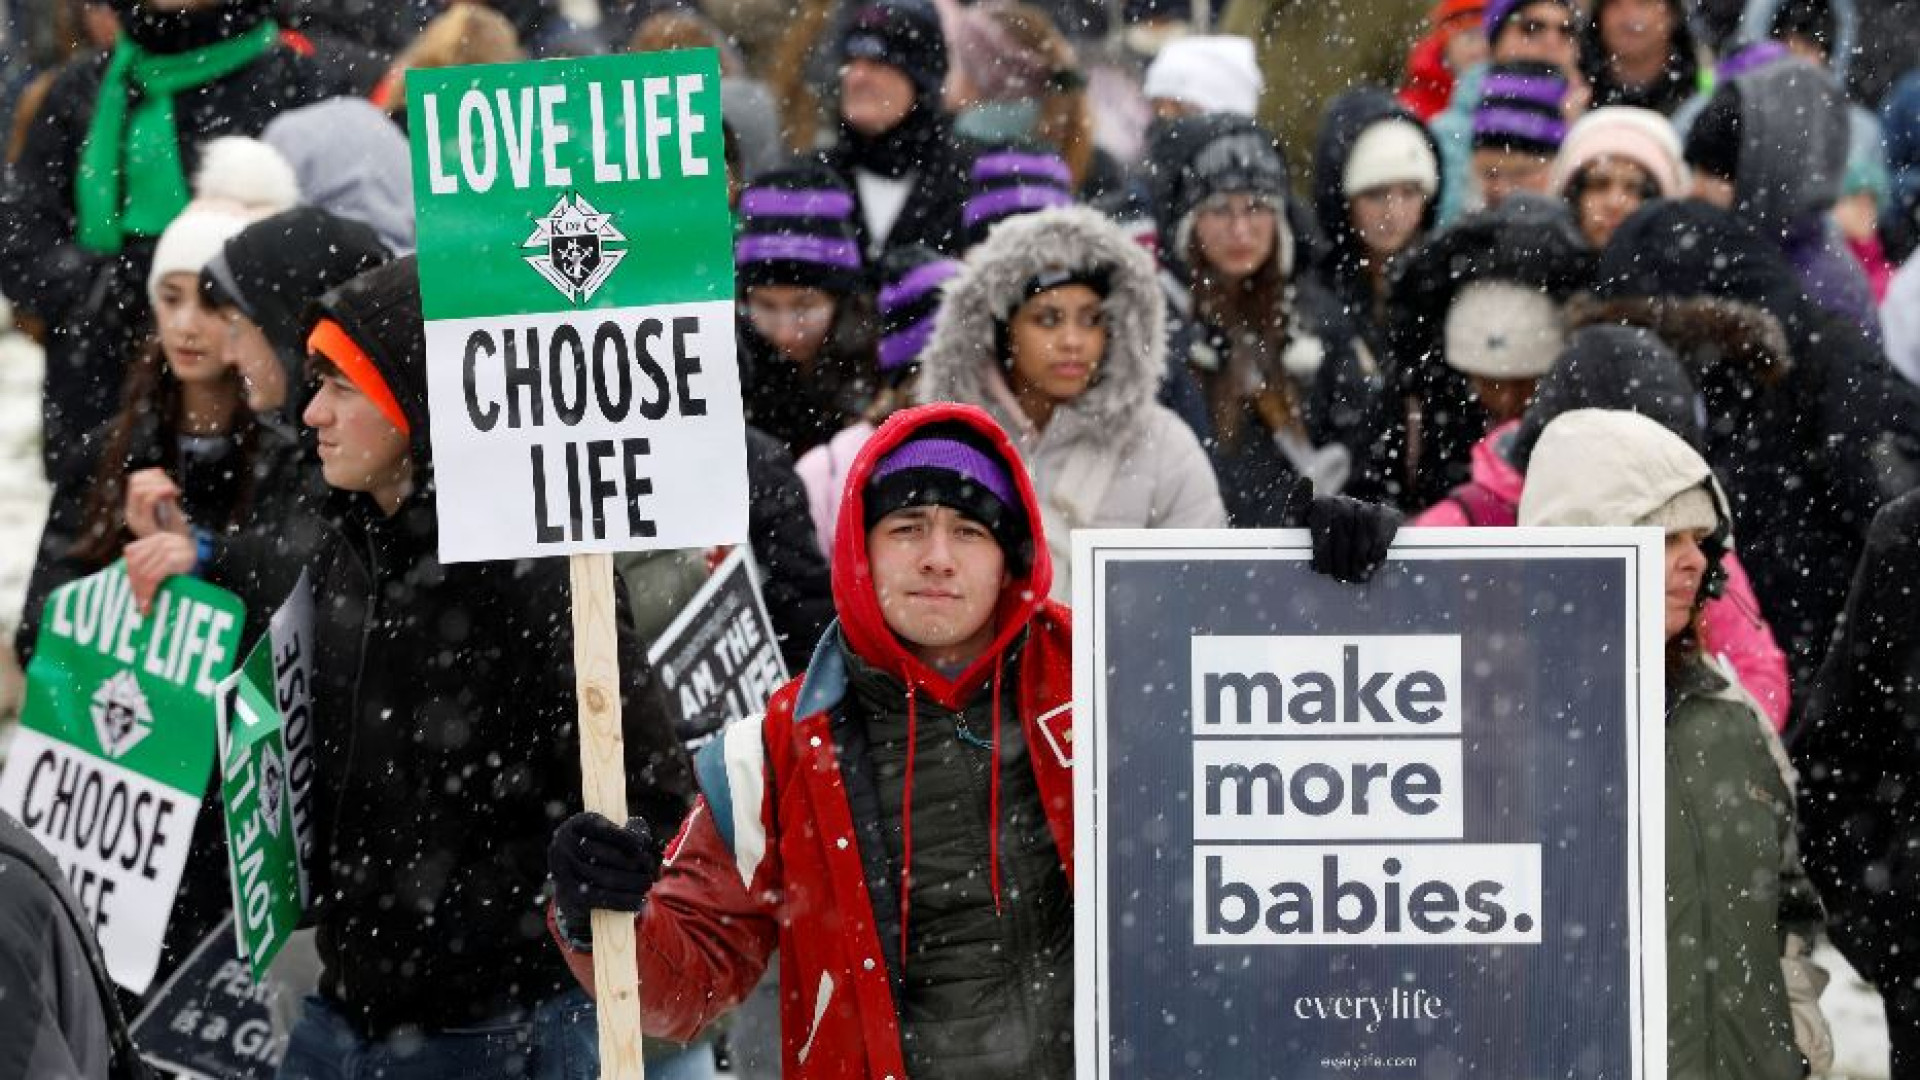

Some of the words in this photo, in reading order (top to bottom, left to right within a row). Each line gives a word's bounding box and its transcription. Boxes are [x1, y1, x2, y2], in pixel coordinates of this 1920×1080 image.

[424, 84, 572, 194] LOVE
[589, 73, 708, 184] LIFE
[551, 219, 564, 235] K
[584, 217, 598, 233] C
[462, 316, 708, 432] CHOOSE
[530, 437, 657, 544] LIFE
[51, 568, 143, 664] LOVE
[143, 590, 235, 697] LIFE
[679, 660, 724, 720] AM
[714, 607, 761, 676] THE
[1204, 644, 1446, 724] make
[21, 749, 175, 881] CHOOSE
[226, 743, 256, 813] LI
[1205, 762, 1442, 816] more
[68, 864, 116, 942] FE
[235, 808, 275, 965] LOVE
[1205, 854, 1534, 935] babies.
[201, 1015, 228, 1041] a
[1294, 987, 1442, 1033] everylife
